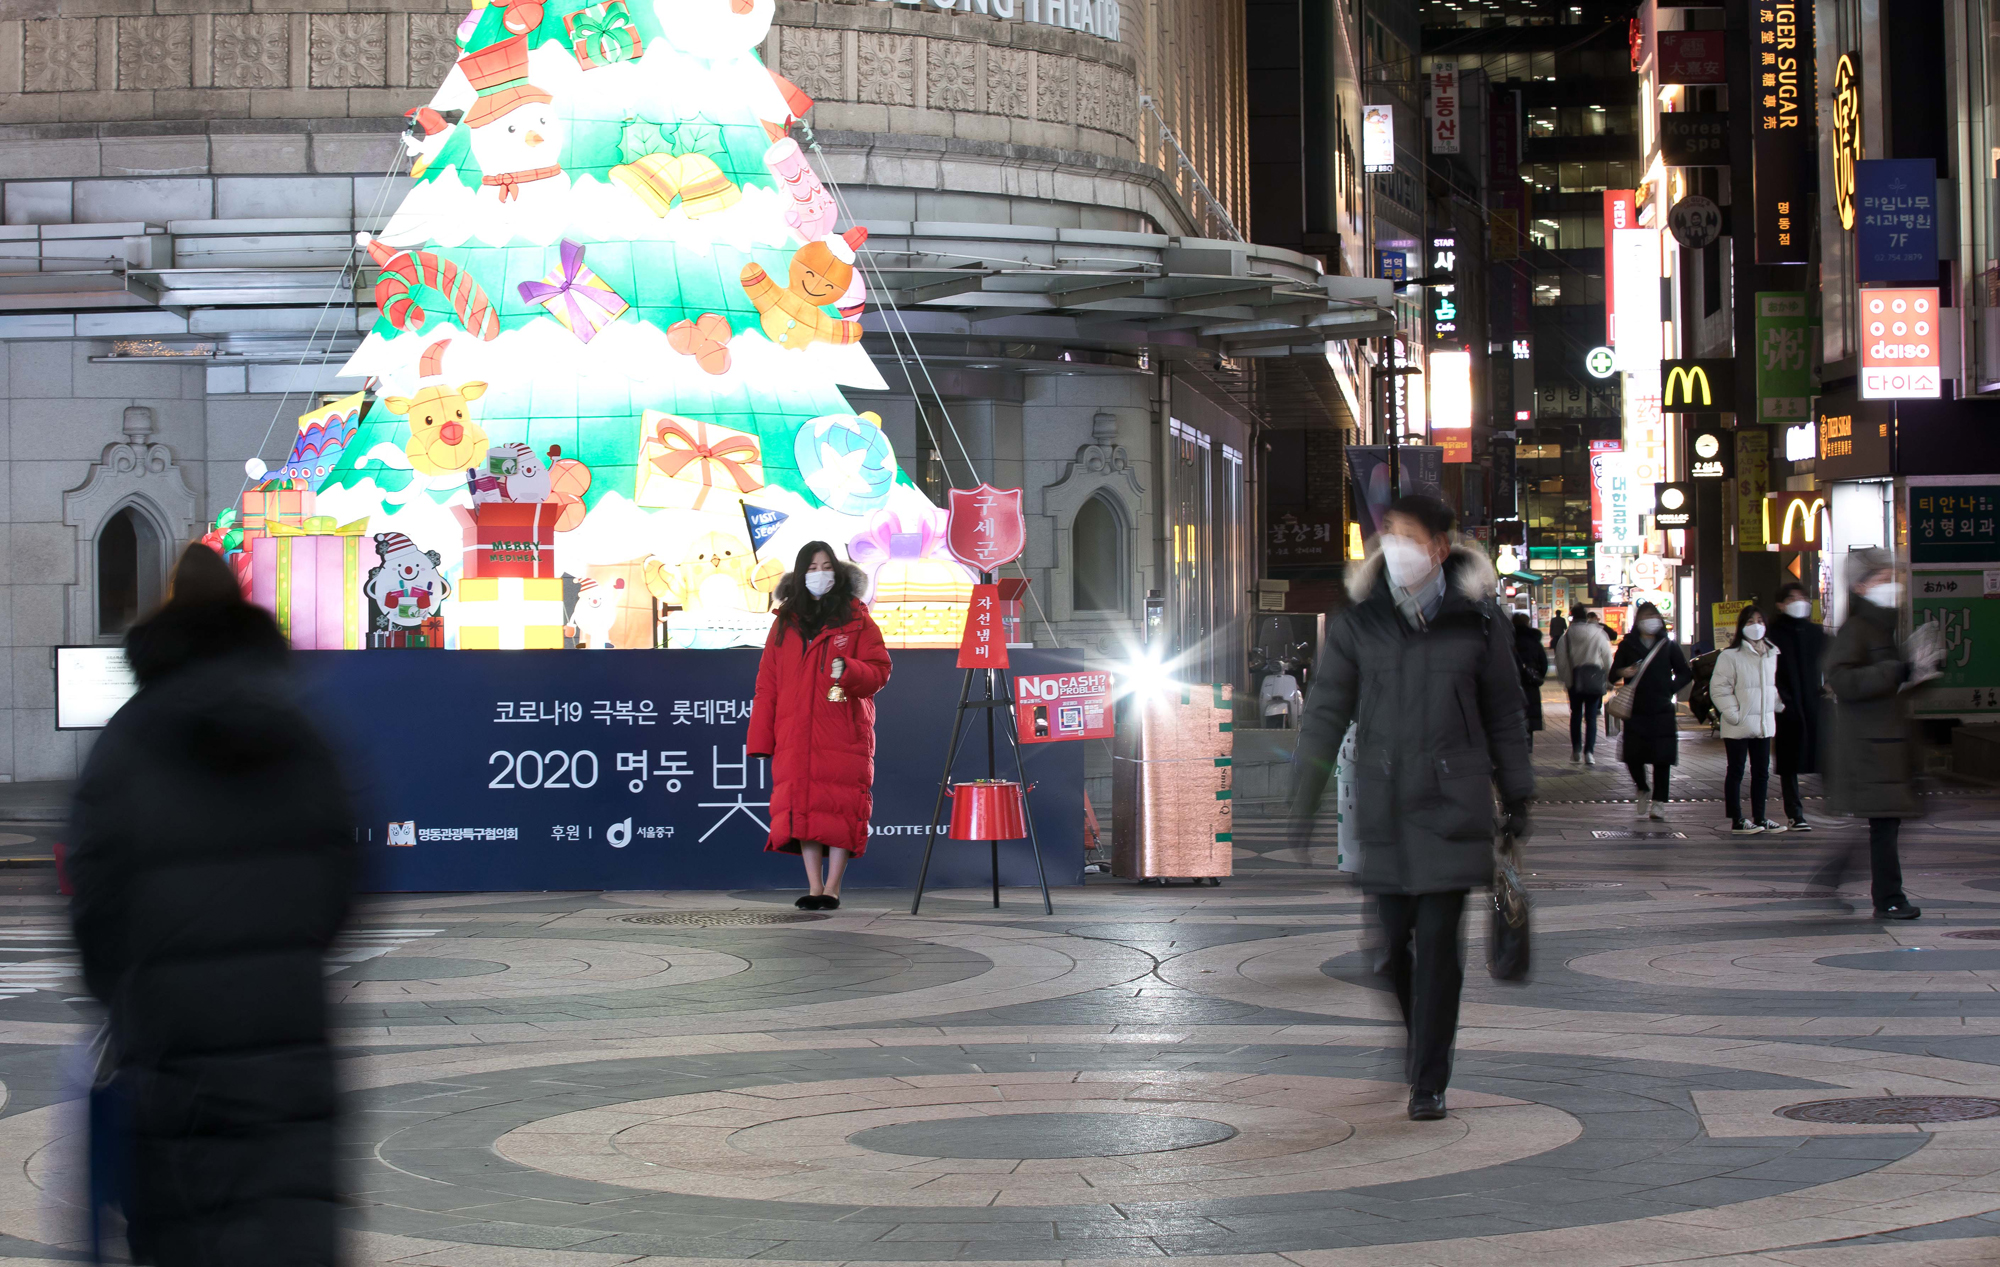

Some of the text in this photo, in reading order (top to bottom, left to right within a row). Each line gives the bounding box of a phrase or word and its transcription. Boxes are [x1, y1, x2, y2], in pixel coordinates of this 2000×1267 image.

[1776, 0, 1799, 129] IGER SUGAR
[1435, 72, 1456, 140] 부동산
[1666, 121, 1721, 134] Korea
[1864, 197, 1930, 211] 라임나무
[1613, 200, 1626, 228] RED
[1865, 214, 1930, 229] 치과병원
[1777, 202, 1791, 246] 명동점
[1434, 238, 1454, 247] STAR
[1889, 233, 1909, 247] 7F
[1383, 258, 1403, 268] 번역
[1435, 322, 1456, 332] Cafe
[1762, 327, 1805, 371] 粥
[1870, 340, 1930, 359] daiso
[1867, 375, 1933, 390] 다이소
[1919, 496, 1976, 513] 티안나
[751, 511, 777, 525] VISIT
[972, 495, 999, 560] 구세군
[1920, 518, 1995, 537] 성형외과
[492, 540, 541, 553] MERRY
[489, 553, 543, 562] MEDIHEAL
[1636, 560, 1659, 585] 약
[1923, 581, 1958, 593] おかゆ
[1718, 601, 1746, 609] MONEY
[975, 596, 993, 659] 자선냄비
[1019, 675, 1106, 700] NO CASH?
[1060, 685, 1106, 695] PROBLEM
[494, 700, 583, 725] 코로나19
[590, 700, 658, 725] 극복은
[488, 750, 599, 789] 2020
[616, 750, 694, 793] 명동
[418, 826, 519, 841] 명동관광특구협의회
[550, 824, 580, 841] 후원
[636, 826, 675, 839] 서울중구
[876, 825, 923, 836] LOTTE
